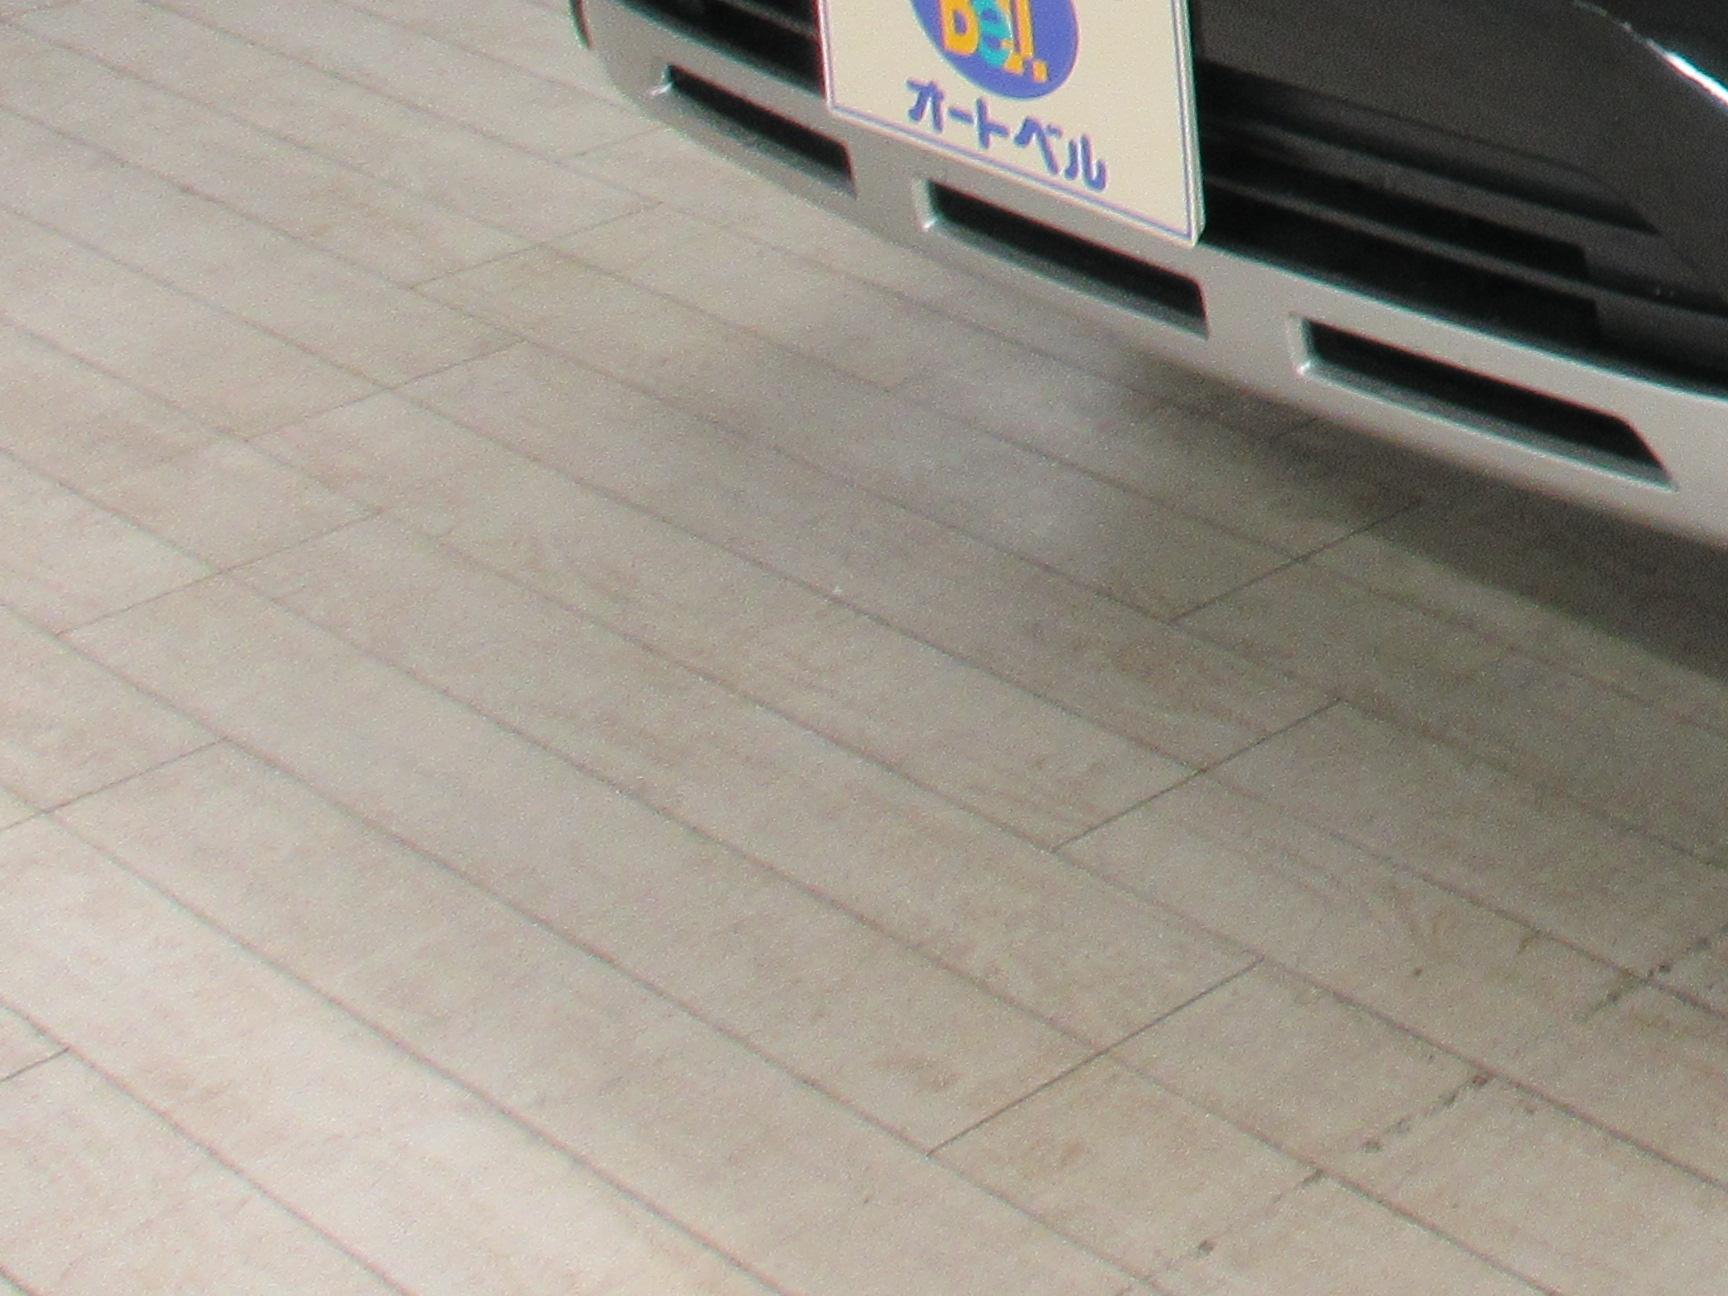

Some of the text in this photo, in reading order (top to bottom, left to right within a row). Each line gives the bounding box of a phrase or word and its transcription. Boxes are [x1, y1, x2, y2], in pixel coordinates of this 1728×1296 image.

[905, 78, 1108, 192] オートベル
